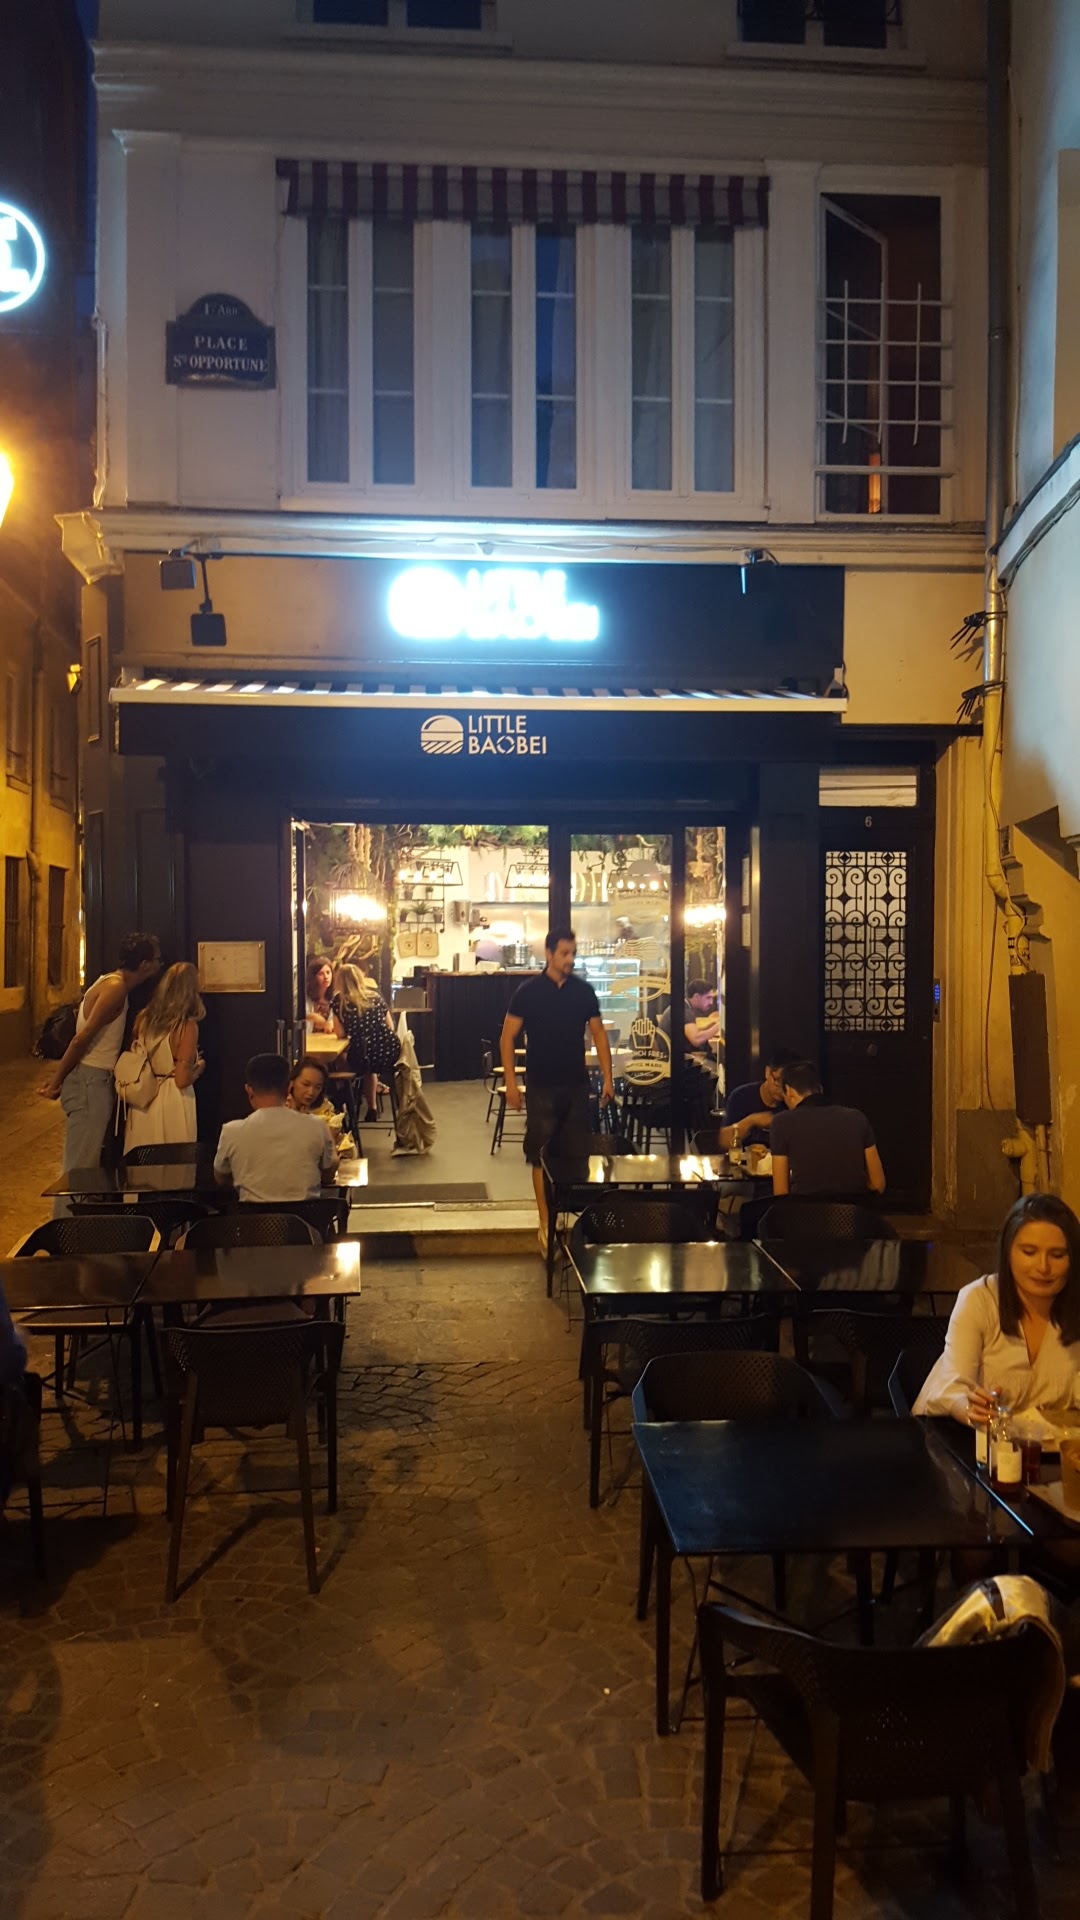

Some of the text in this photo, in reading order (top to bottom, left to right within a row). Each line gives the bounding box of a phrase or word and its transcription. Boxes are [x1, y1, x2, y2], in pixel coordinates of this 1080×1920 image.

[194, 335, 248, 351] PLACE
[189, 354, 268, 372] OPPORTUNE
[468, 715, 527, 733] LITTLE
[468, 735, 547, 754] BAOBEI
[864, 815, 873, 828] 6
